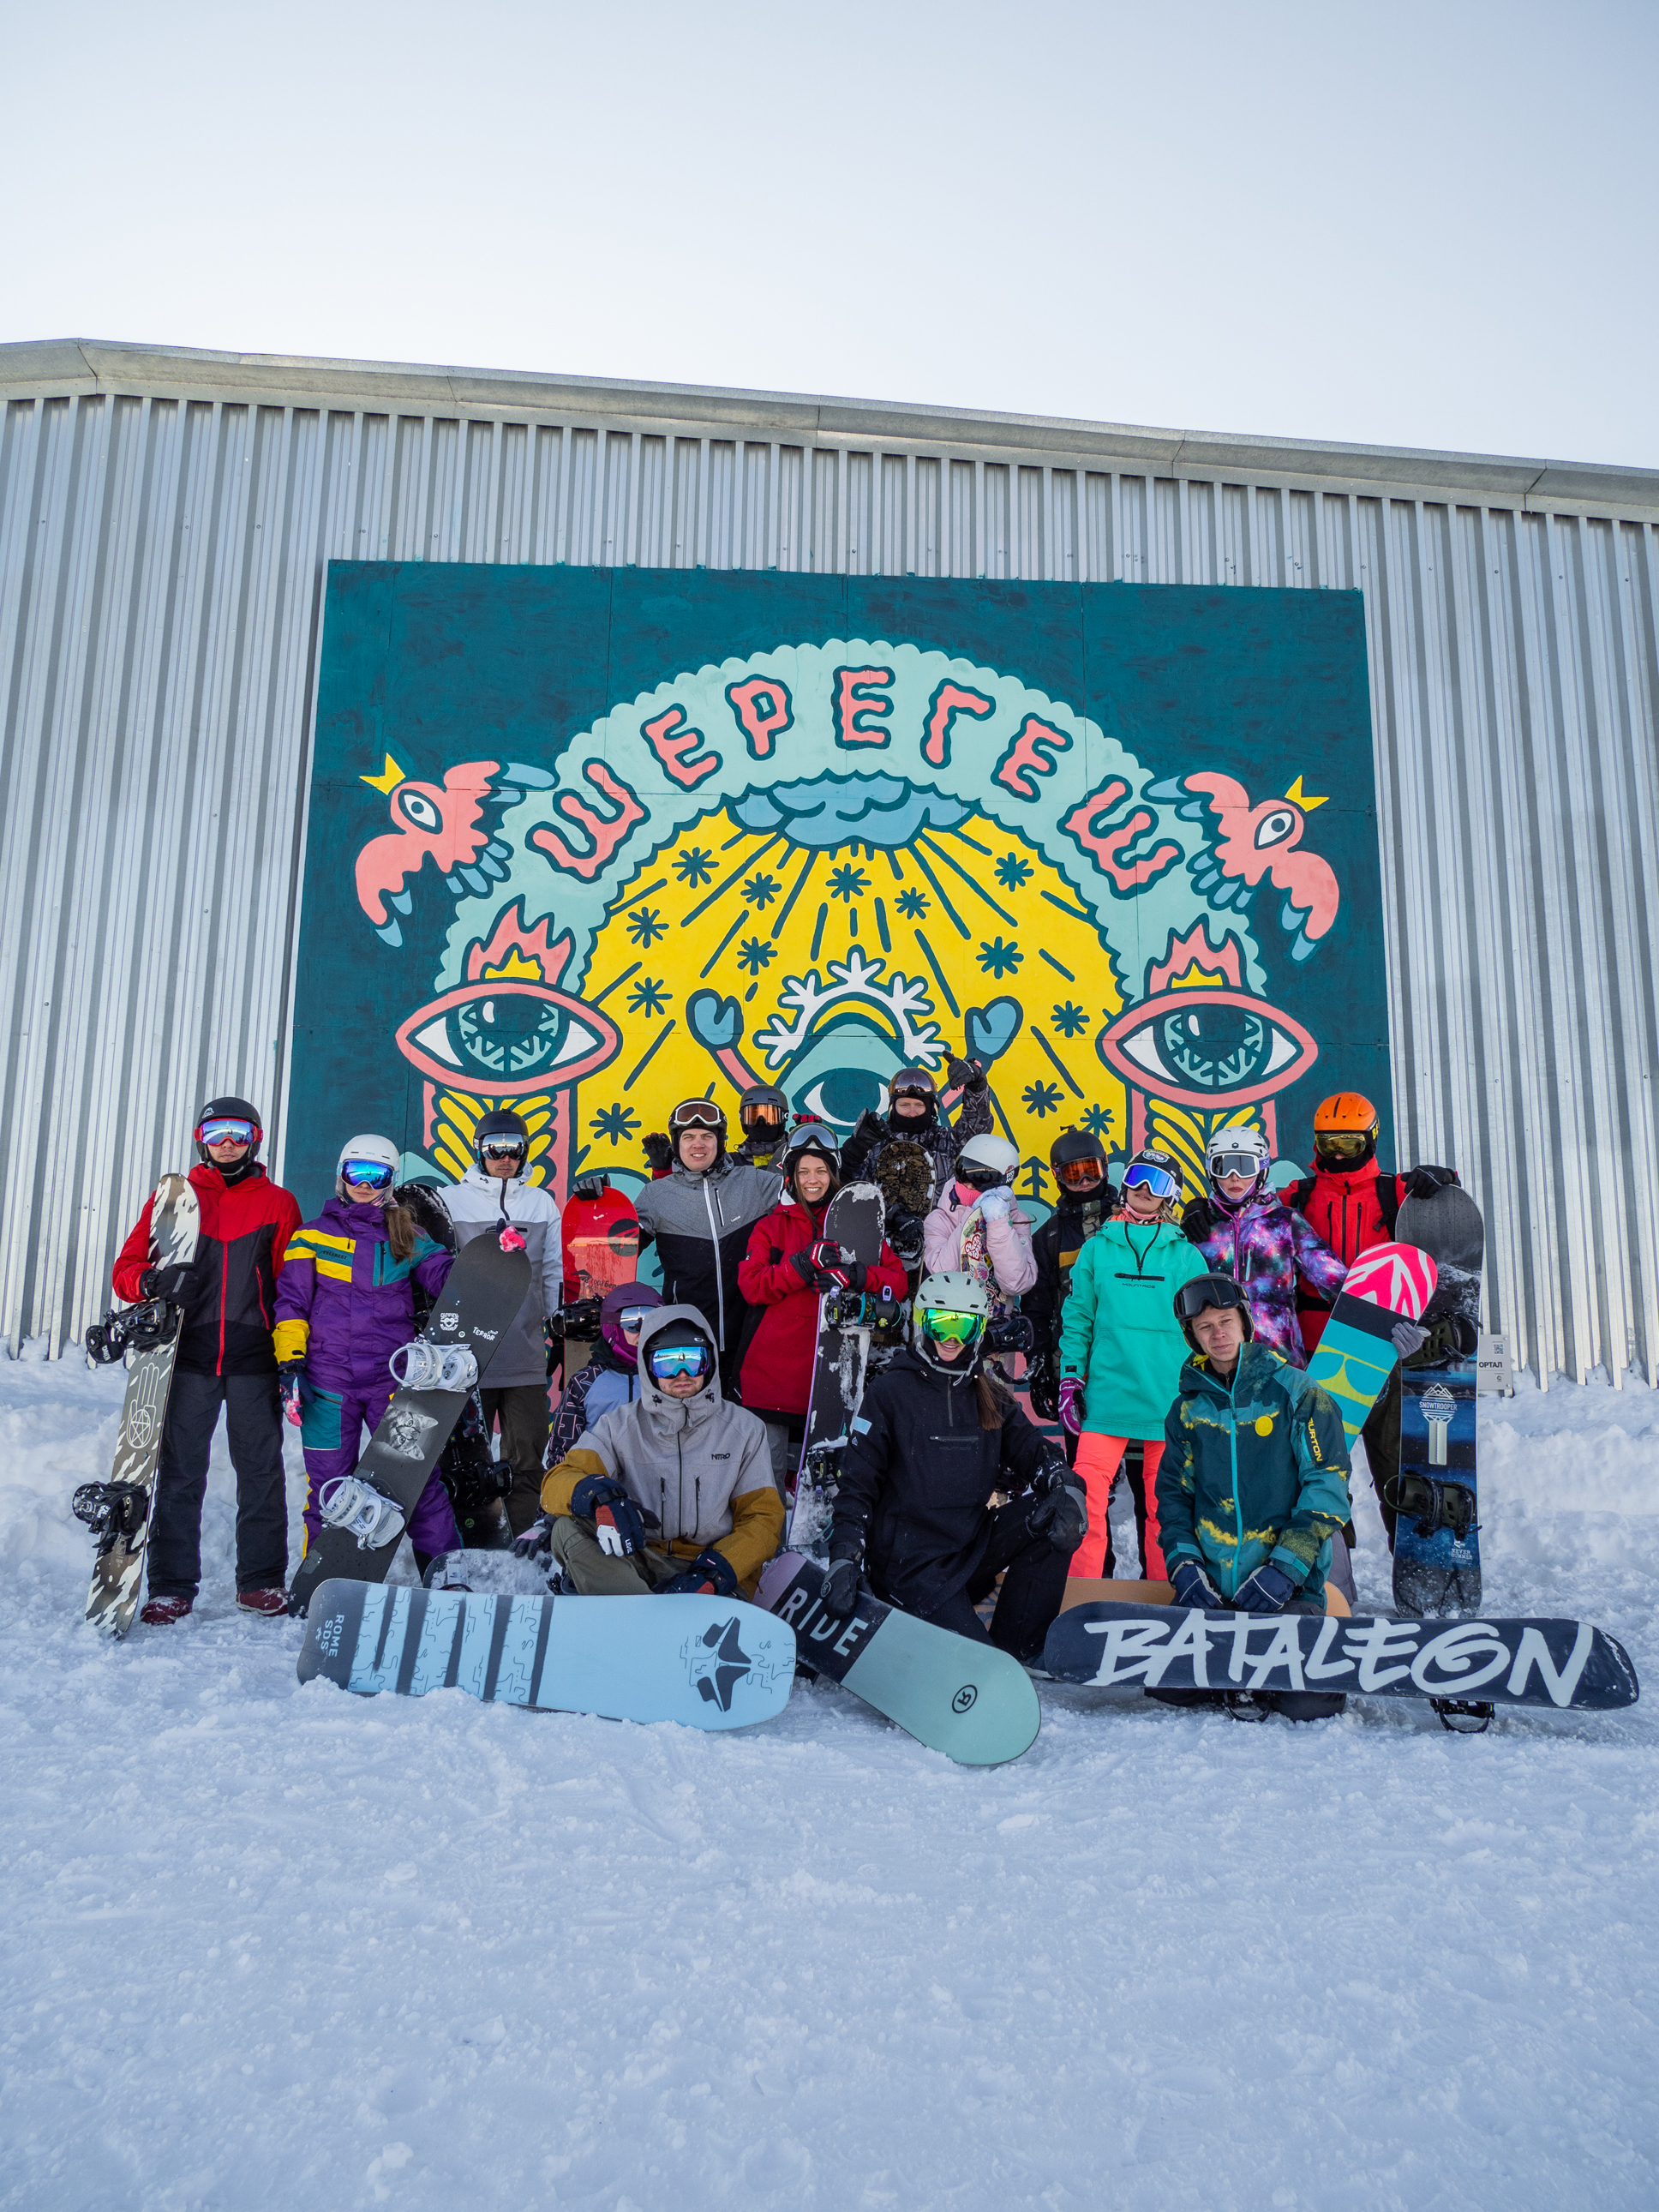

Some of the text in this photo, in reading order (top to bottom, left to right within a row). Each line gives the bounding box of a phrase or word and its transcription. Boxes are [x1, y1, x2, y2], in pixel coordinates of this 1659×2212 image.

[525, 665, 1185, 891] ШЕРЕГЕШ
[473, 1326, 495, 1340] TERROR
[1419, 1401, 1457, 1411] SNOWTROOPER
[320, 1620, 333, 1651] SDS
[328, 1615, 344, 1658] ROME
[777, 1587, 869, 1657] RIDE
[1083, 1608, 1593, 1707] BATALEON
